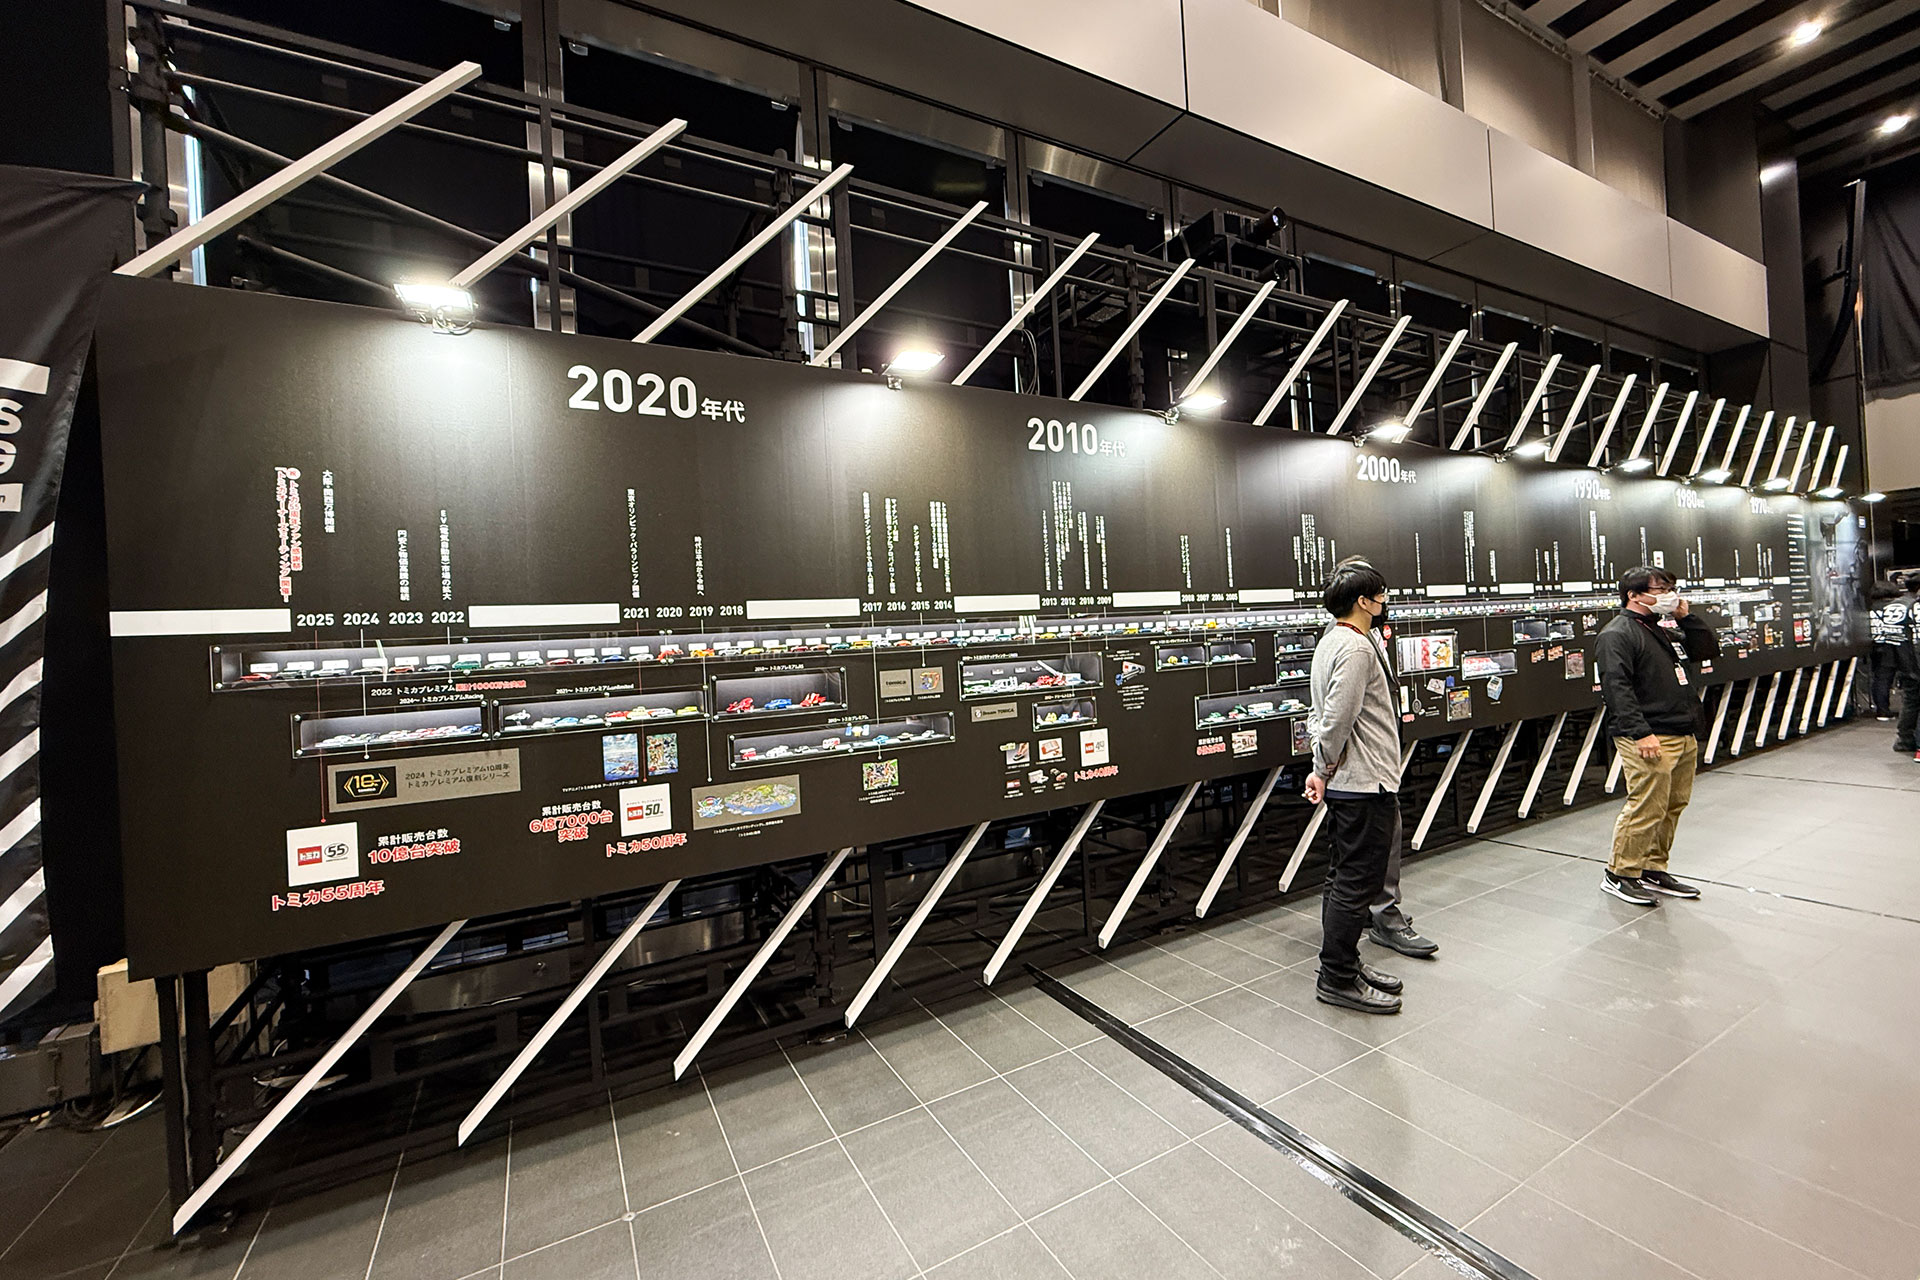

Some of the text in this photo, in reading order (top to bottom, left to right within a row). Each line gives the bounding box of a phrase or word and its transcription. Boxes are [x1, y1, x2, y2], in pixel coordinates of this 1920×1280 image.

[567, 364, 746, 424] 2020年代
[1027, 417, 1127, 458] 2010年代
[1356, 454, 1417, 483] 2000年代
[862, 600, 953, 612] 2017 2016 2015 2014
[1041, 597, 1057, 606] 2013
[1060, 597, 1076, 606] 2012
[296, 611, 465, 627] 2025 2024 2023 2022
[623, 605, 744, 619] 2021 2020 2019 2018
[371, 688, 392, 697] 2022
[405, 771, 425, 780] 2024
[542, 800, 602, 817] 累計販売台数
[529, 810, 614, 833] 6億7000台
[377, 828, 449, 847] 累計販売台数
[558, 826, 589, 843] 突破
[325, 843, 347, 857] 55
[367, 838, 461, 865] 10億台突破
[605, 833, 688, 858] トミカ50周年
[271, 879, 385, 912] トミカ55周年
